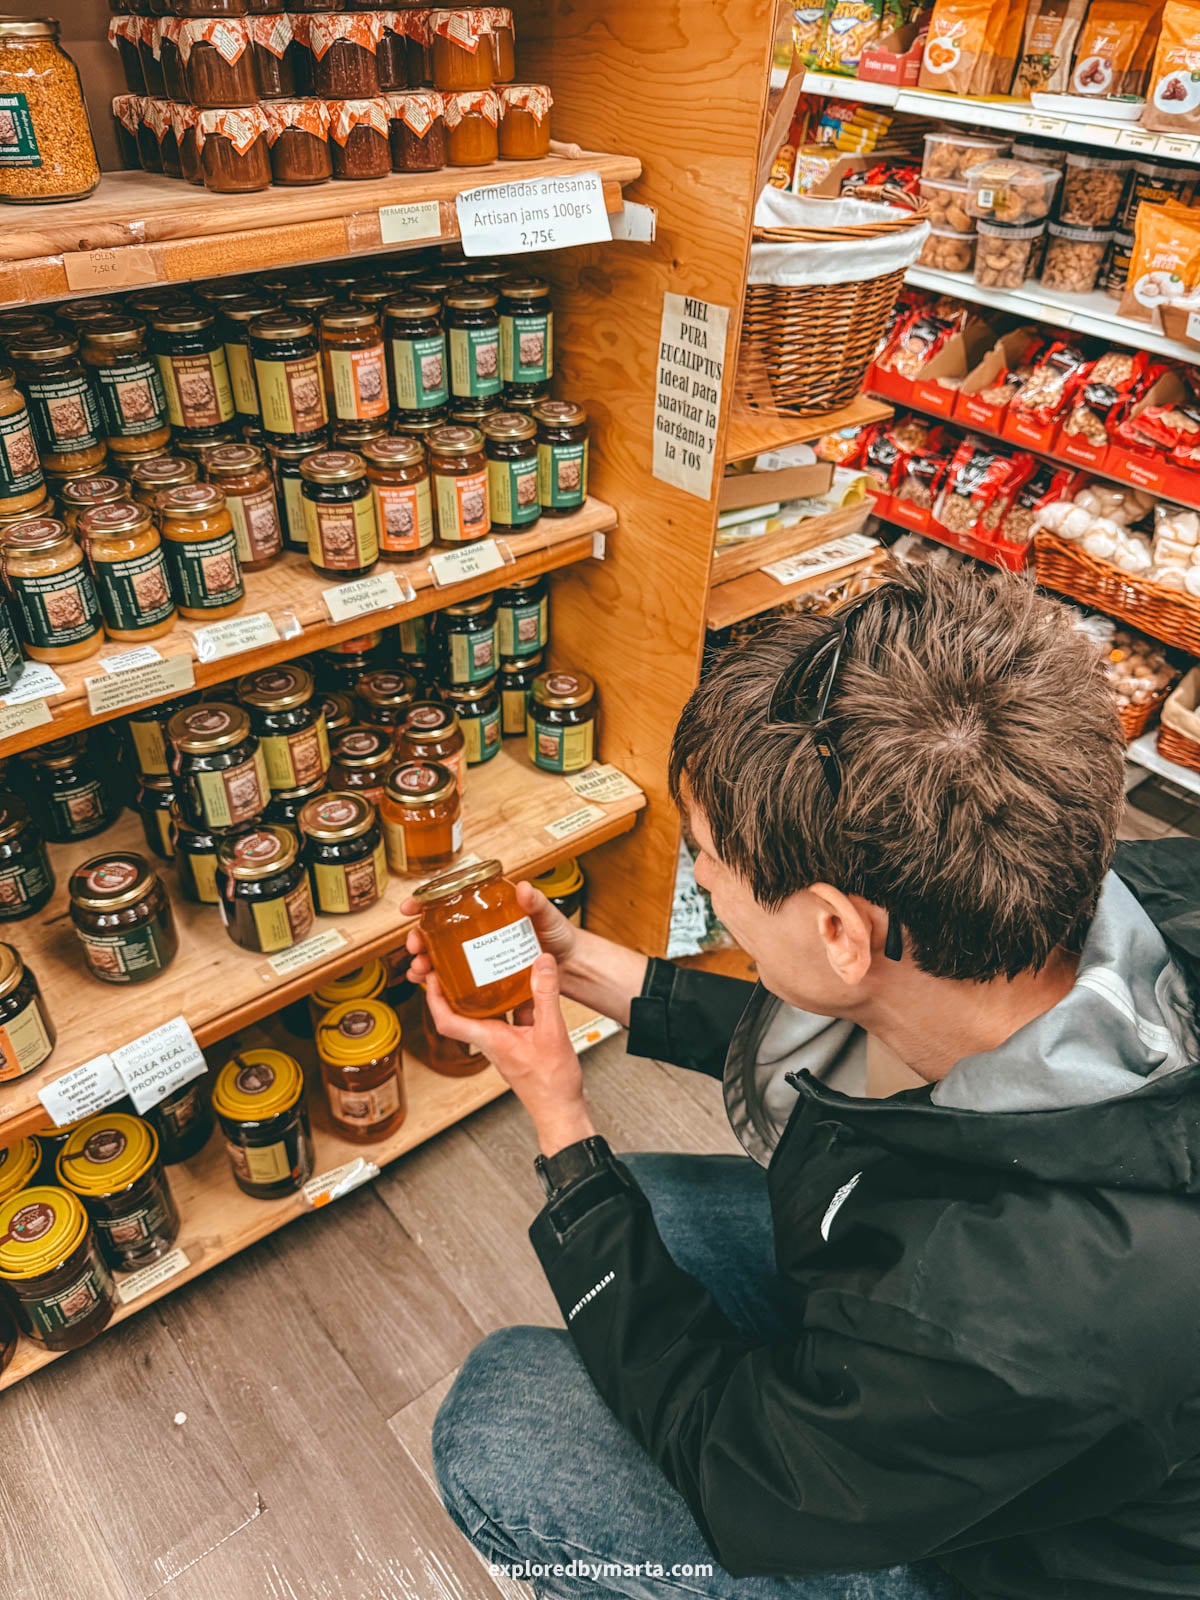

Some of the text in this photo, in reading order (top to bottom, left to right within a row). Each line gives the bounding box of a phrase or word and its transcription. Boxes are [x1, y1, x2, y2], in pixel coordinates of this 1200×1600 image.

[541, 178, 597, 195] artesanas
[380, 204, 421, 217] MERMELADA
[401, 216, 419, 225] 2,75€
[473, 202, 592, 228] Artisan jams 100grs
[520, 228, 556, 247] 2,75€
[90, 252, 116, 261] POLEN
[684, 297, 709, 323] MIEL
[680, 322, 707, 349] PURA
[660, 342, 722, 381] EUCALIPTUS
[659, 367, 718, 405] Ideal para
[657, 392, 717, 430] suavizar la
[656, 414, 715, 454] Garganta y
[664, 441, 702, 471] la TOS
[92, 674, 113, 684] MIEL
[142, 1023, 177, 1044] NATURAL
[128, 1060, 159, 1082] JALEA
[160, 1045, 185, 1063] REAL
[132, 1061, 182, 1094] PROPOLEO
